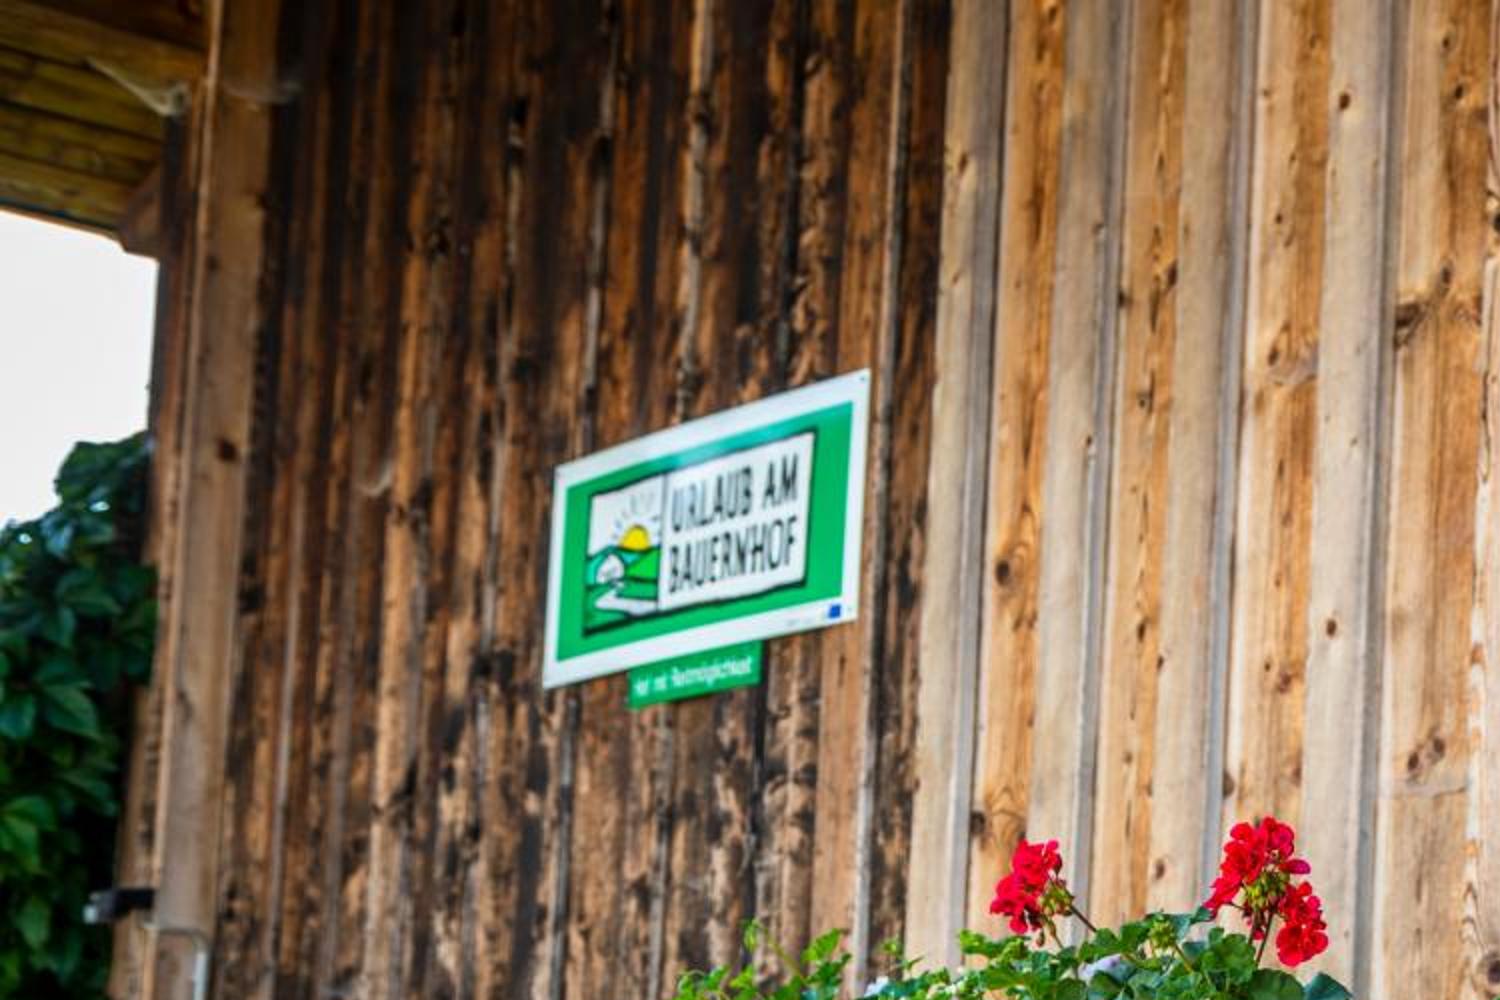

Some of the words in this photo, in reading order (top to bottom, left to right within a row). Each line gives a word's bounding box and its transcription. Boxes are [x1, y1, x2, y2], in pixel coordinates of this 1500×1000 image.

[672, 467, 752, 532] URLAUB
[763, 454, 798, 507] AM
[669, 516, 798, 592] BAUERNHOF
